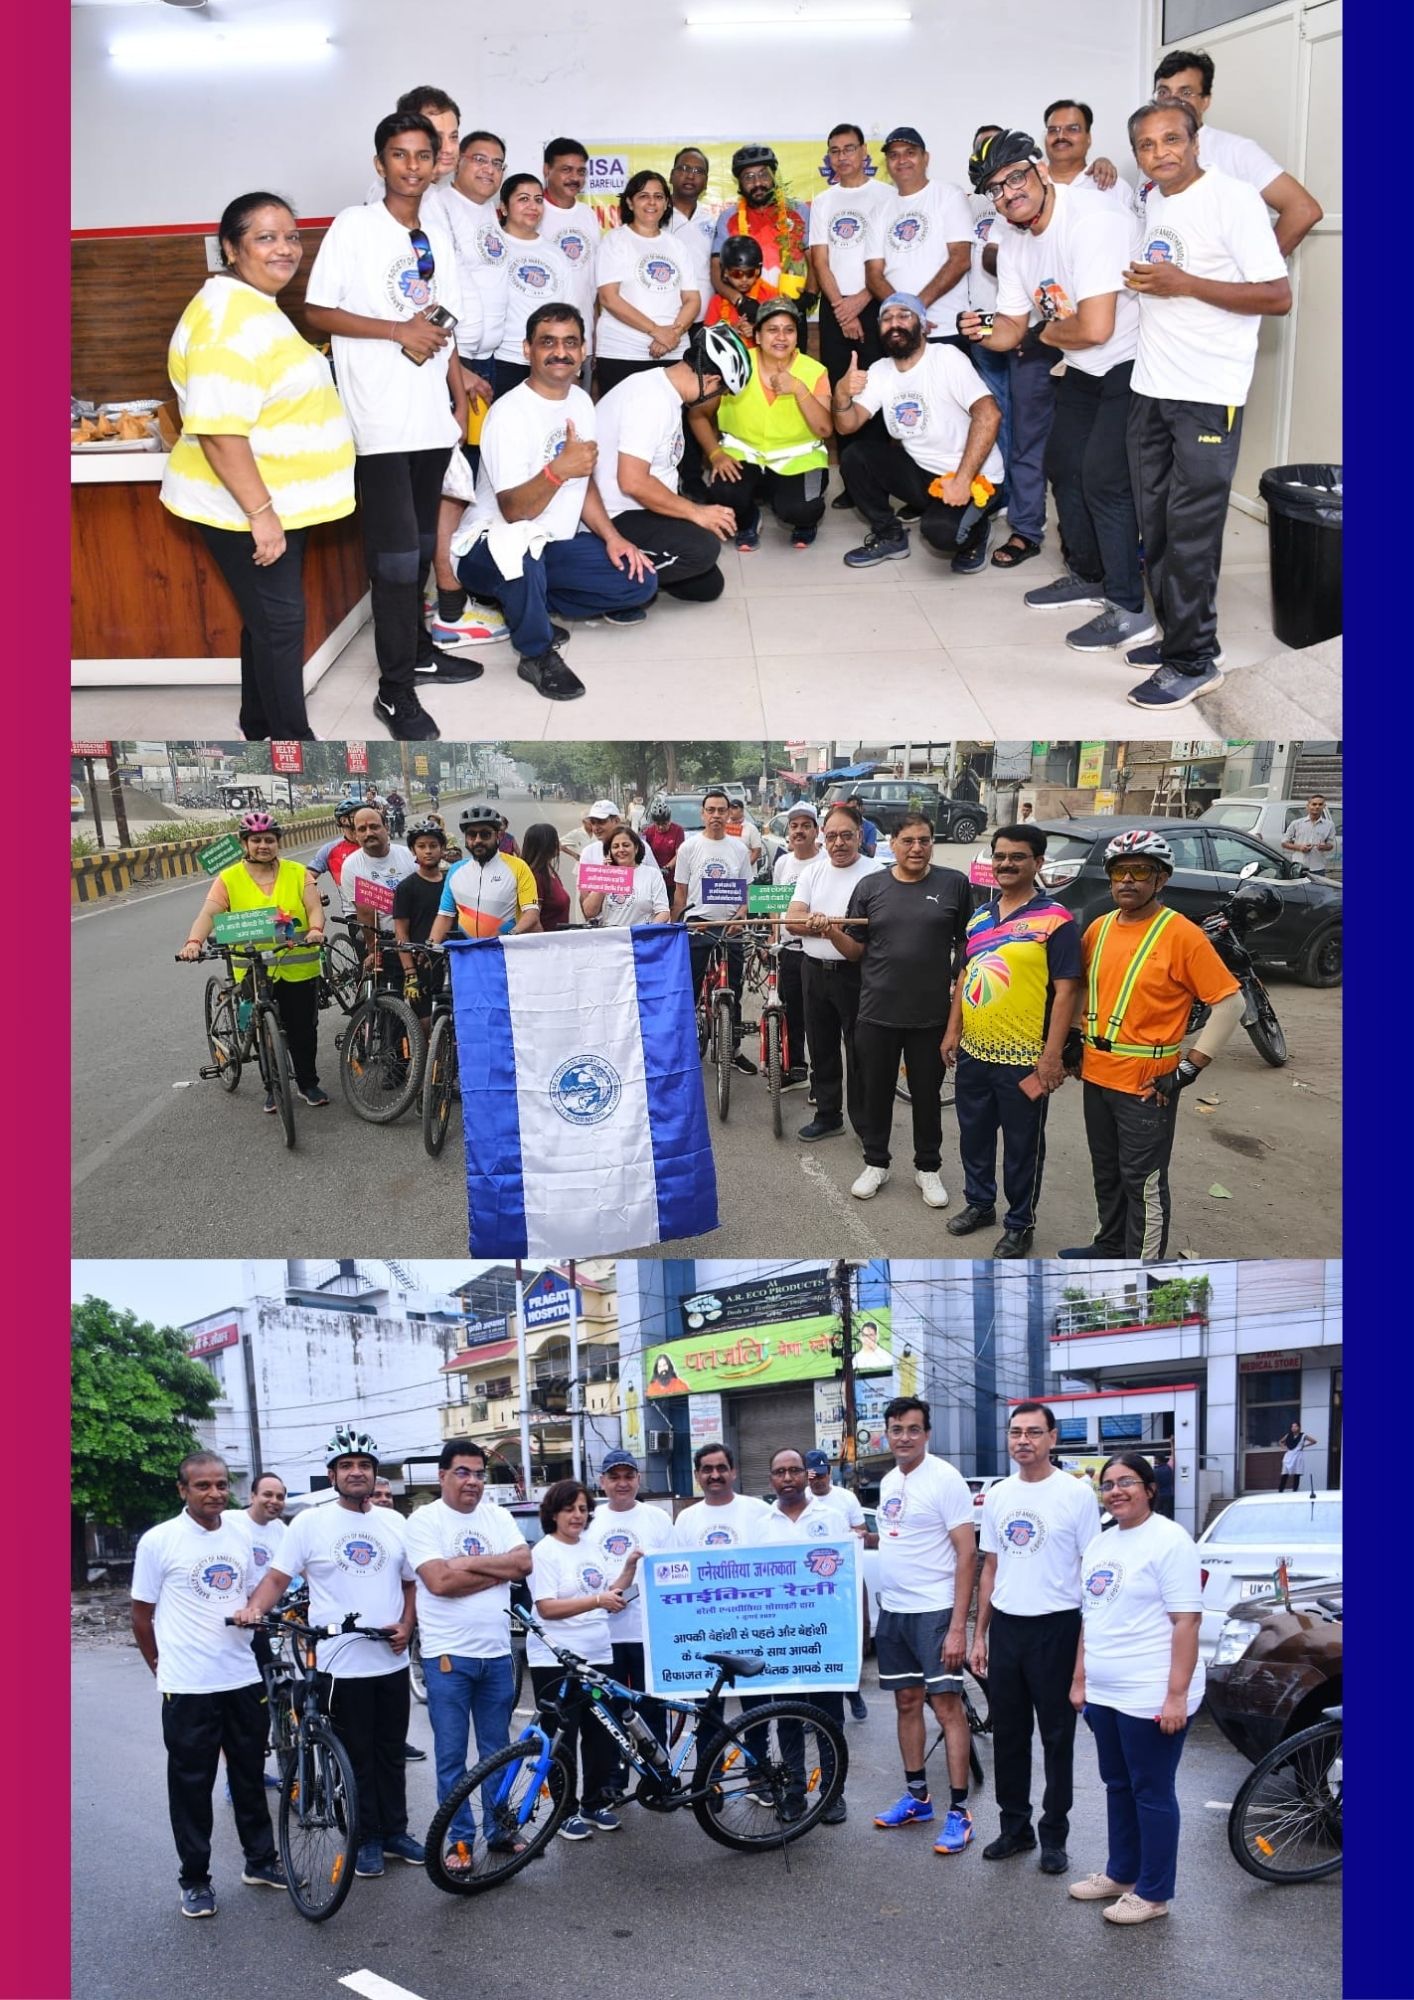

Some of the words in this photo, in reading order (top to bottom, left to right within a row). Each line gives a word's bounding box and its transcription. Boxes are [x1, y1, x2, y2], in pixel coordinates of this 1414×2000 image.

[589, 159, 625, 176] ISA
[589, 179, 625, 189] BAREILLY
[746, 1289, 767, 1299] ECO
[768, 1278, 825, 1295] PRODUCTS
[528, 1289, 571, 1310] PRAGAT
[527, 1304, 570, 1324] HOSPITA
[1240, 1360, 1273, 1372] MEDICAL
[1274, 1357, 1300, 1369] STORE
[670, 1563, 689, 1574] ISA
[673, 1628, 707, 1644] आपकी
[708, 1627, 738, 1642] बेहोशी
[739, 1627, 750, 1640] से
[751, 1626, 776, 1640] पहले
[777, 1624, 796, 1638] और
[798, 1622, 828, 1637] बेहोशी
[681, 1649, 693, 1662] के
[766, 1645, 787, 1658] साथ
[788, 1641, 823, 1655] आपकी
[661, 1668, 702, 1682] हिफाजत
[704, 1666, 714, 1680] में
[791, 1661, 822, 1675] आपके
[824, 1662, 844, 1674] साथ
